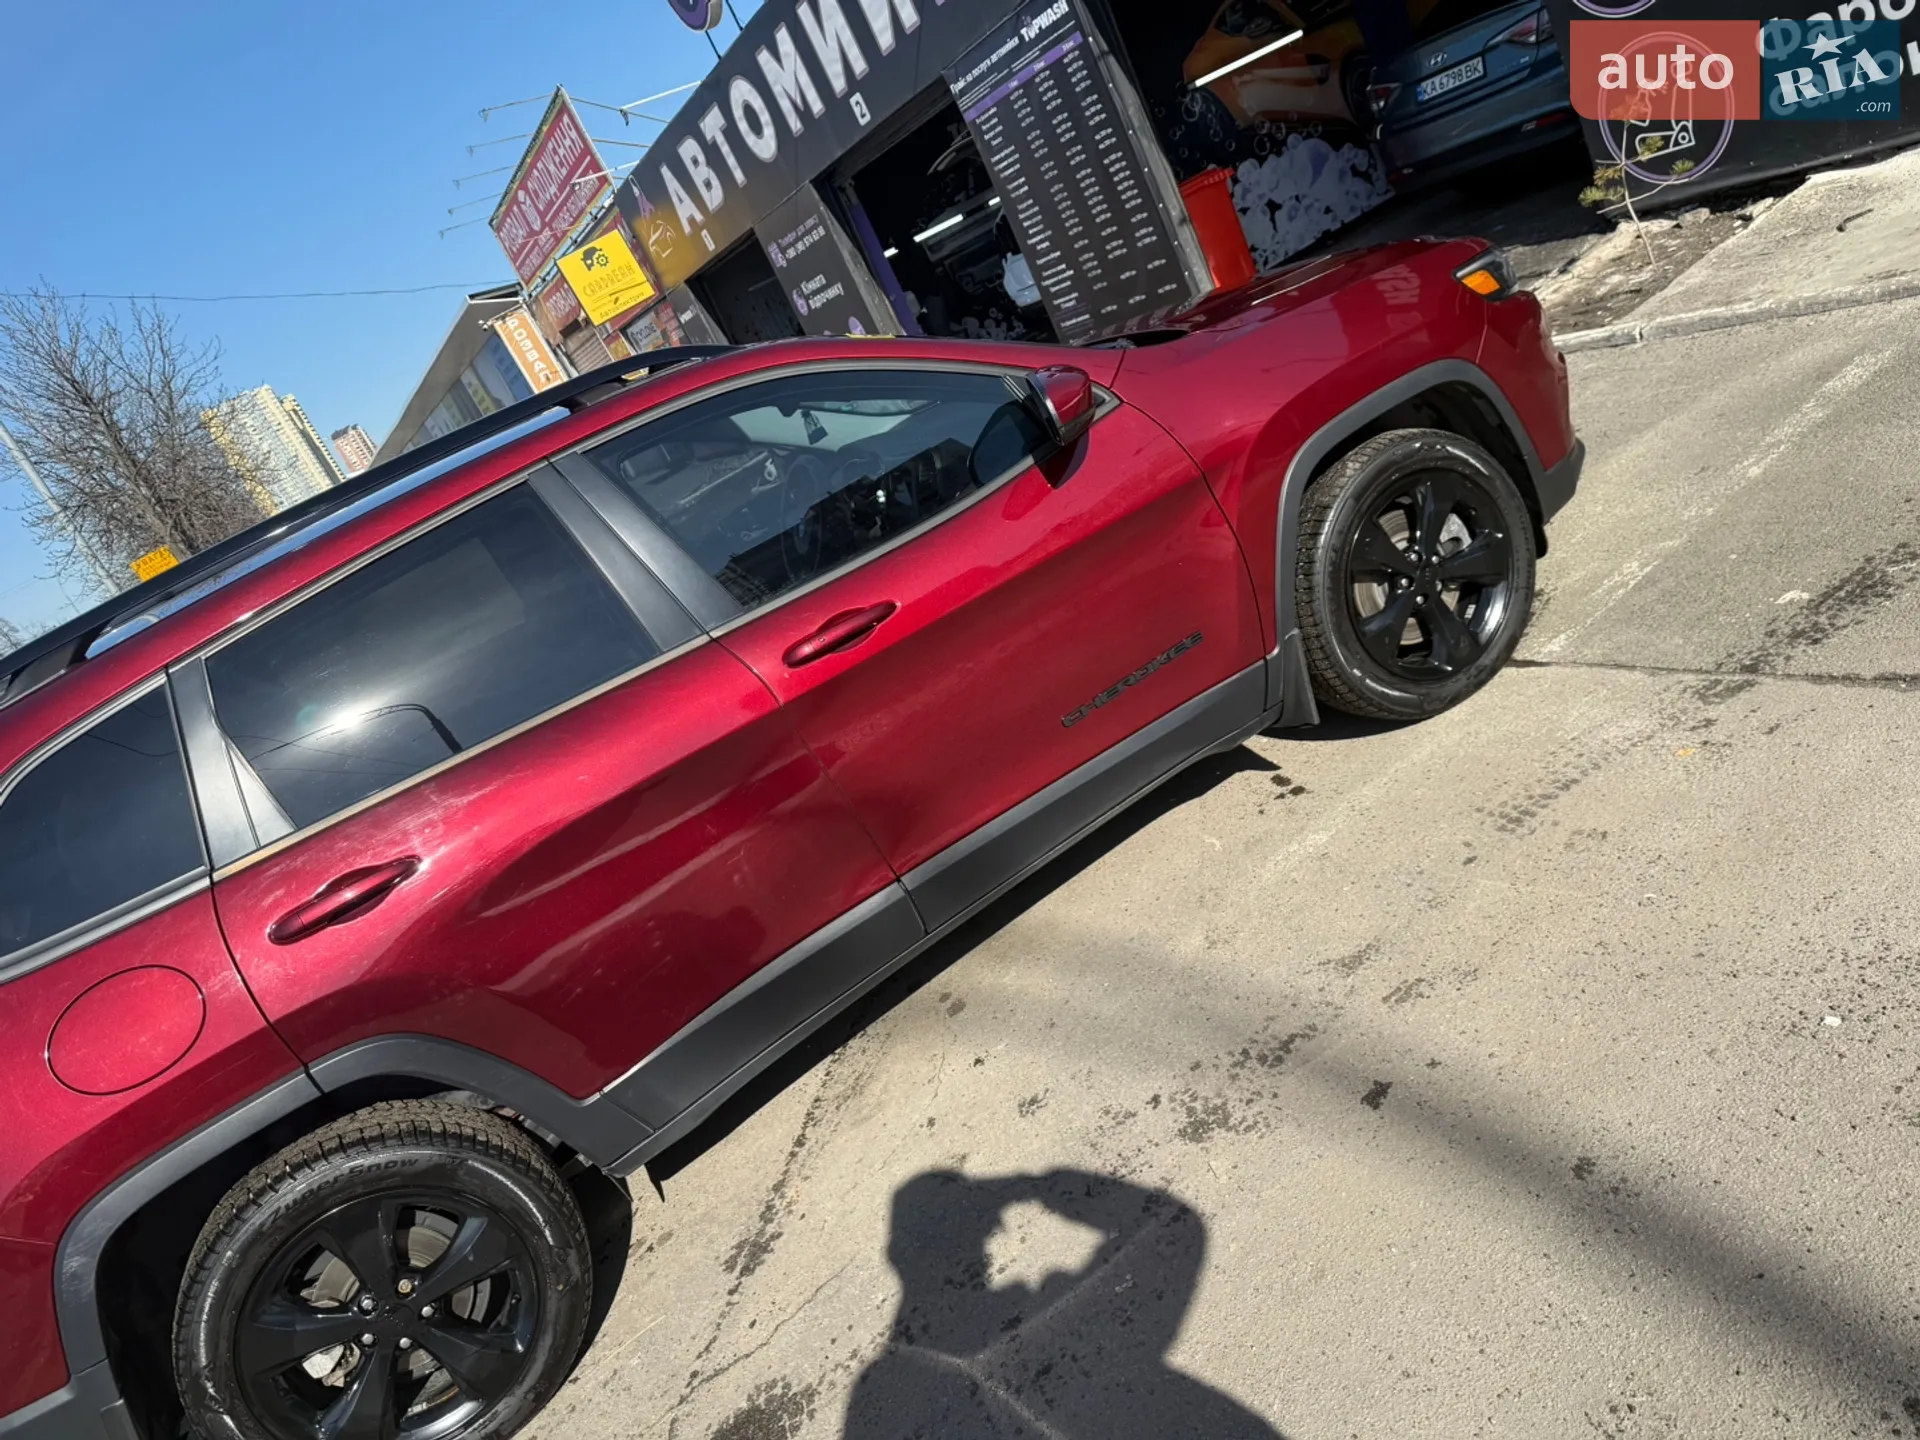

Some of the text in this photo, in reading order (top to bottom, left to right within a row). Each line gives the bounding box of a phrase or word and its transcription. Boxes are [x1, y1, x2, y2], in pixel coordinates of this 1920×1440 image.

[1020, 0, 1069, 42] TOPWASH
[972, 59, 992, 78] послуги
[990, 36, 1020, 63] автомийки
[1421, 81, 1438, 97] KA
[1439, 69, 1463, 91] 6798
[1465, 60, 1482, 79] BK
[1061, 630, 1204, 727] CHEROKEE
